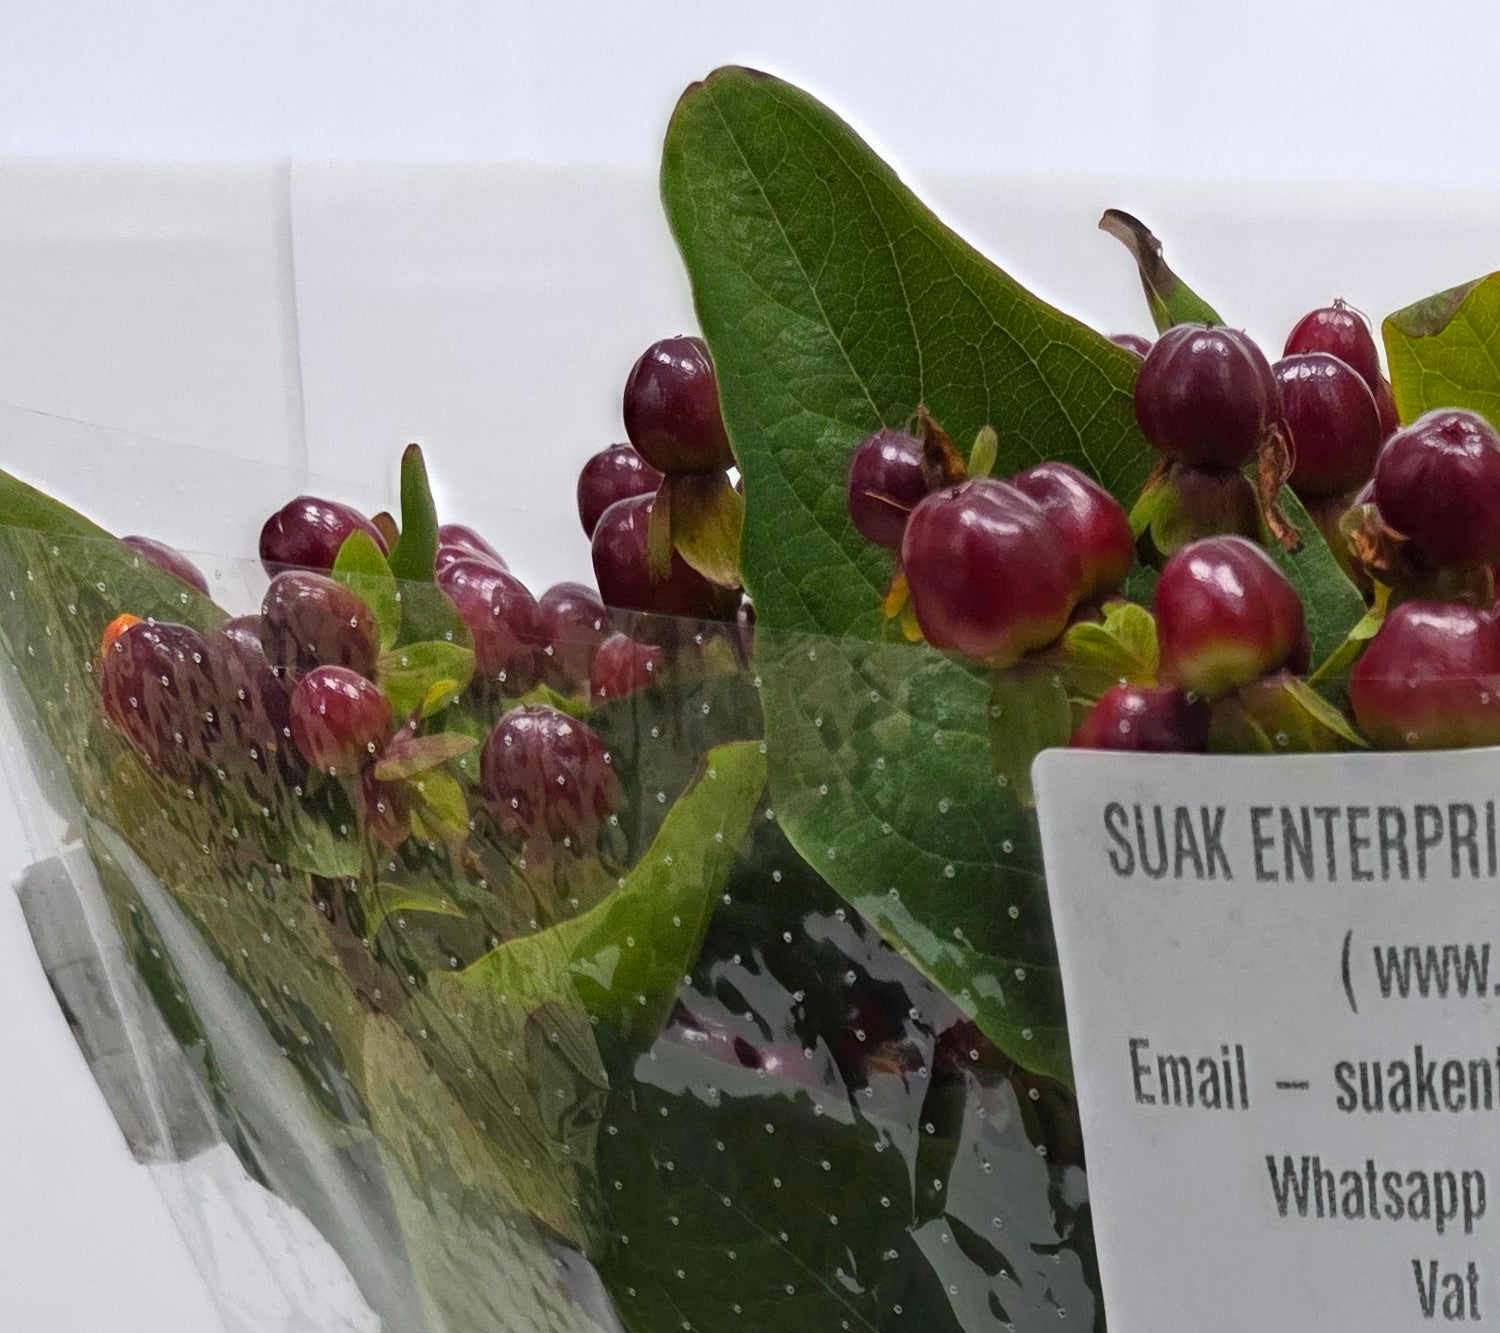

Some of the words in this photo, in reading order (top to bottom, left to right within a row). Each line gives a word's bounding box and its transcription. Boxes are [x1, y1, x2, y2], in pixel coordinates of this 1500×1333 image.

[1104, 801, 1233, 879] SUAK
[1129, 1038, 1249, 1110] Email
[1266, 1155, 1487, 1234] Whatsapp
[1412, 1259, 1481, 1321] Vat
